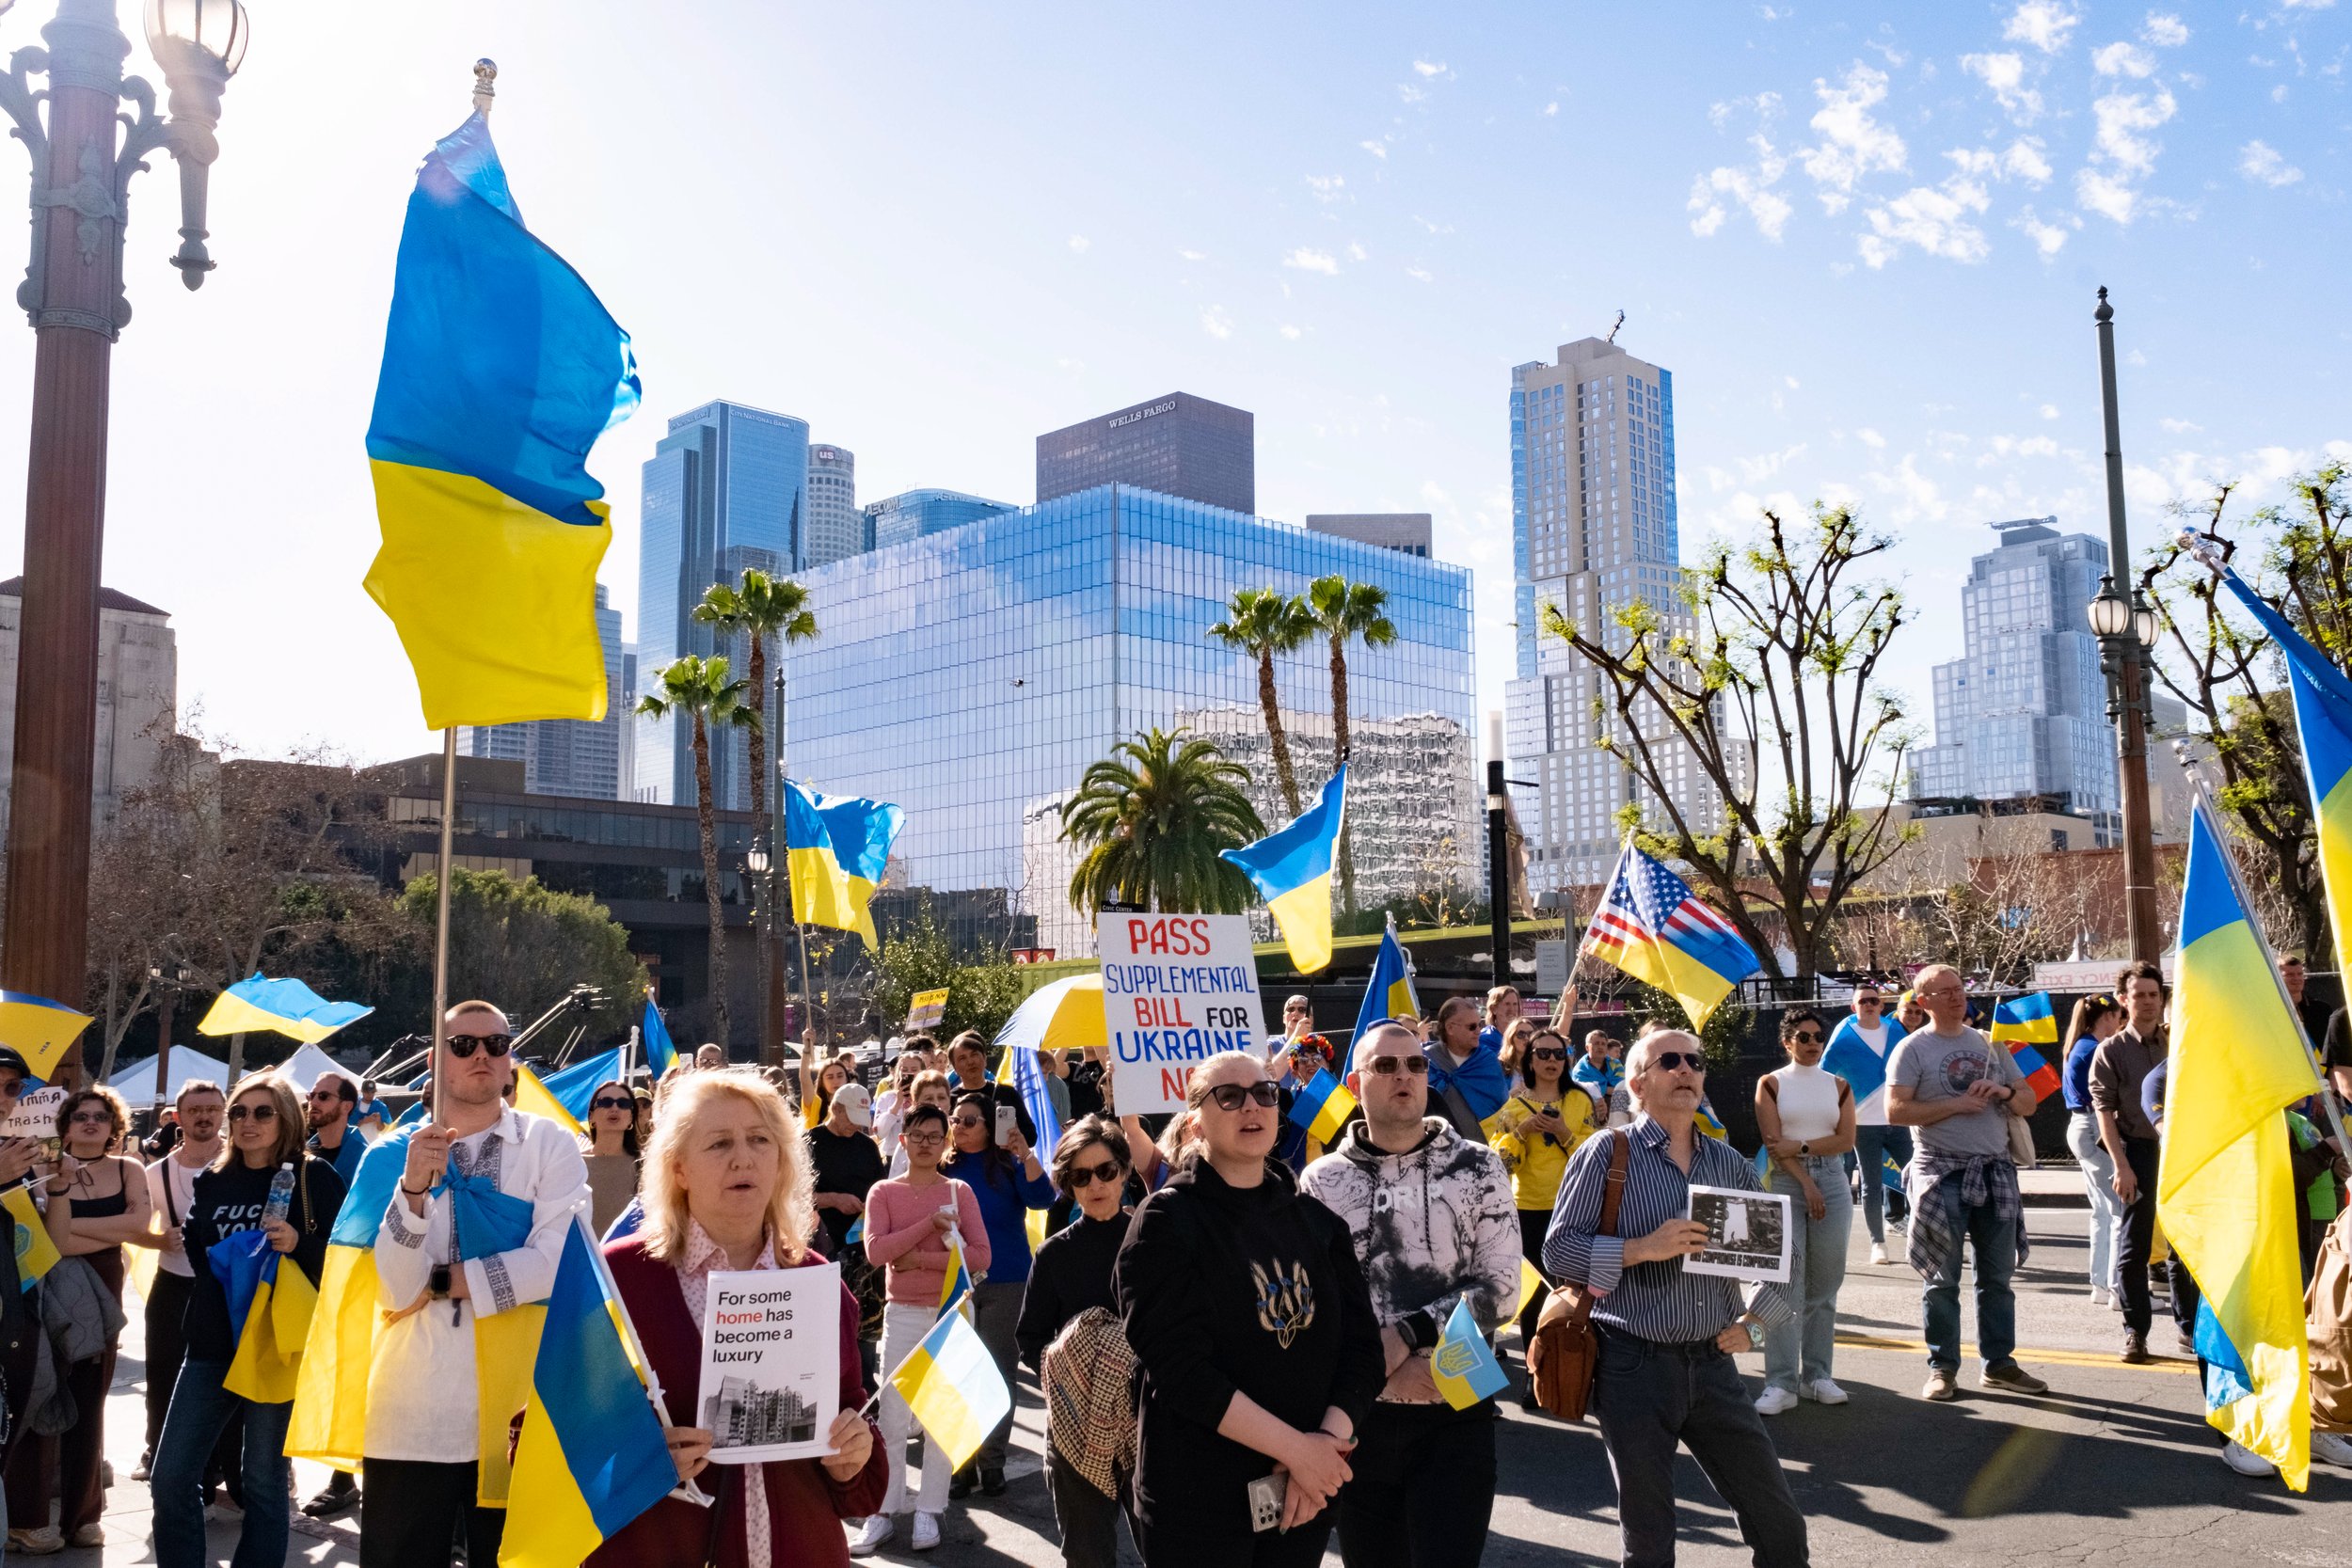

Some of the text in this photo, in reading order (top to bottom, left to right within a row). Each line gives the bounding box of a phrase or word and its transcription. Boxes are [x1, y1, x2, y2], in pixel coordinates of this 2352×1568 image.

[743, 413, 772, 425] NATIONAL
[773, 420, 789, 429] BANK
[1109, 401, 1176, 429] WELLS FARGO
[866, 496, 900, 516] AECOM
[1128, 918, 1211, 956] PASS
[1105, 963, 1256, 994] SUPPLEMENTAL
[1134, 997, 1250, 1028] BILL FOR
[1374, 1183, 1444, 1212] DRIP
[212, 1204, 262, 1220] FUC
[718, 1290, 792, 1306] For some
[716, 1308, 793, 1324] home has
[714, 1329, 793, 1344] become a
[712, 1349, 763, 1364] luxury
